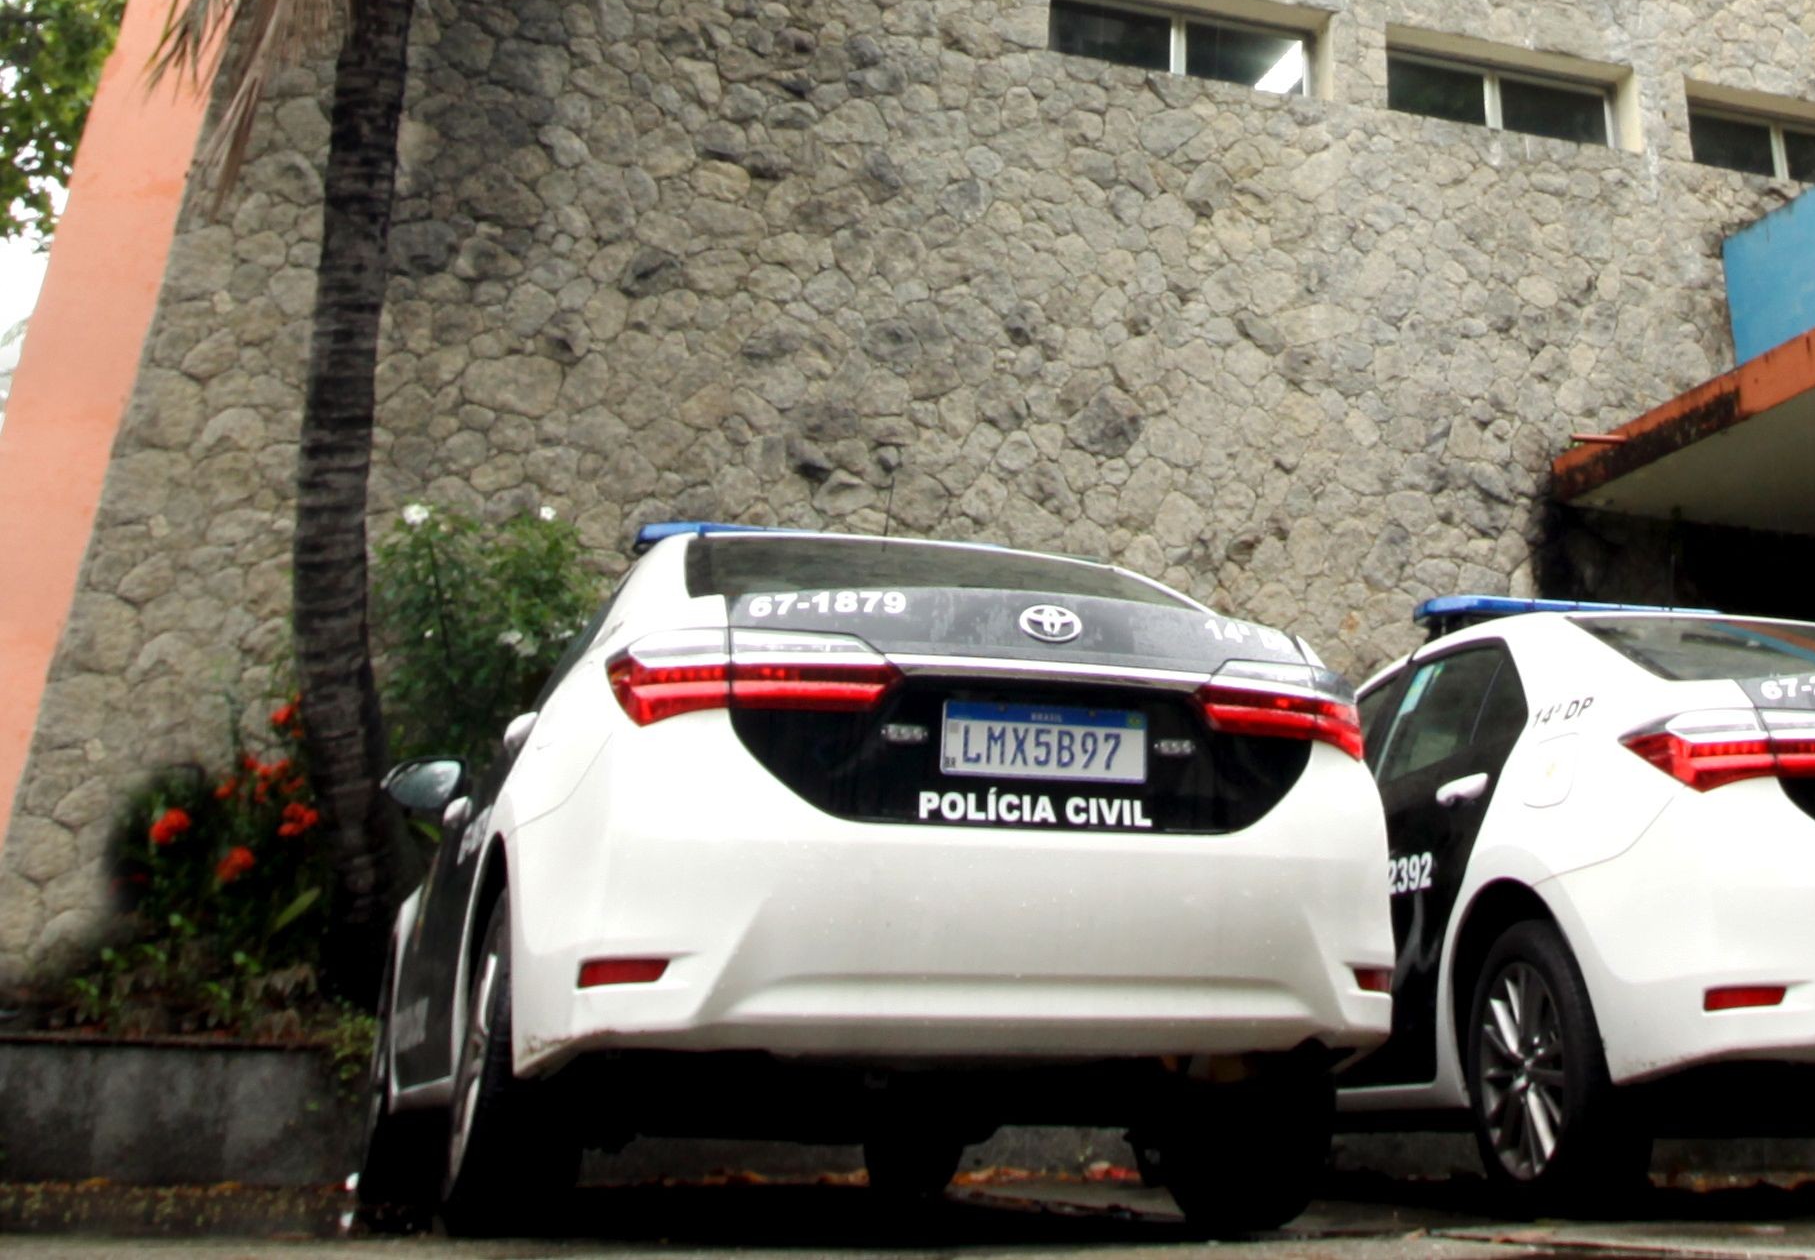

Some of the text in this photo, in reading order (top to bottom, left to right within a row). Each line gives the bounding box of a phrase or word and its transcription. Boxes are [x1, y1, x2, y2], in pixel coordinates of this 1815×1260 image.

[749, 591, 906, 617] 67-1879
[1563, 696, 1594, 720] DP
[962, 725, 1122, 771] LMX5B97
[919, 787, 1153, 827] POLÍCIA CIVIL
